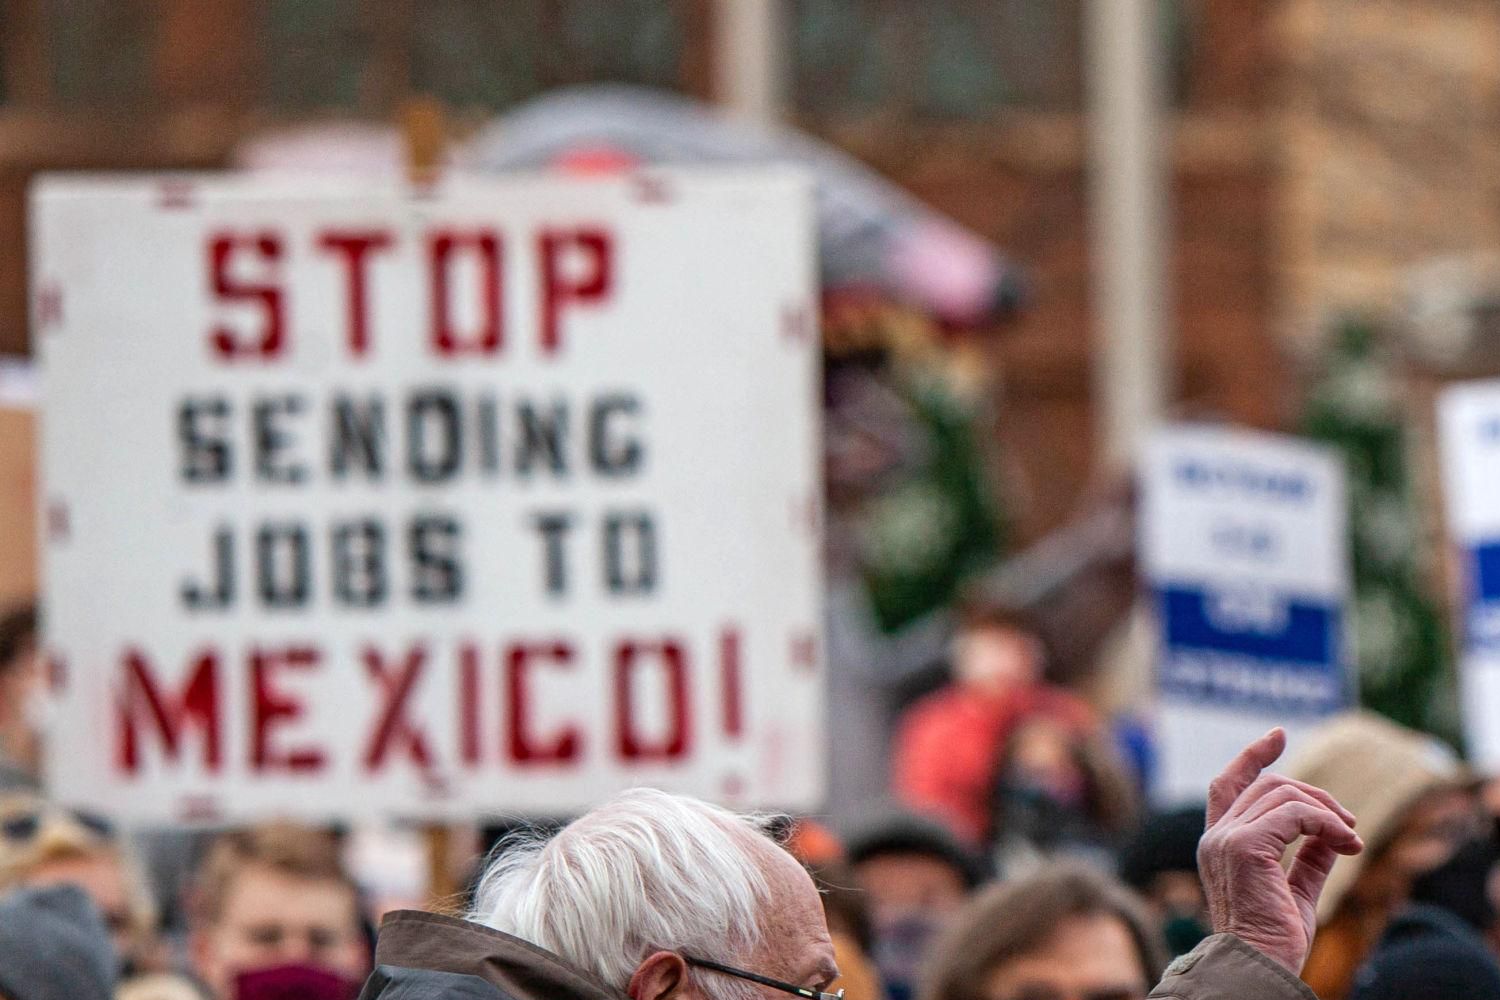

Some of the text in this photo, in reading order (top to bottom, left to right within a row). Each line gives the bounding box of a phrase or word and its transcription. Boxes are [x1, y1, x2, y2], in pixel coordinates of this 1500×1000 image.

[205, 225, 616, 360] STOP
[177, 388, 646, 484] SENDING
[181, 508, 659, 610] JOBS TO
[113, 622, 747, 798] MEXICO!
